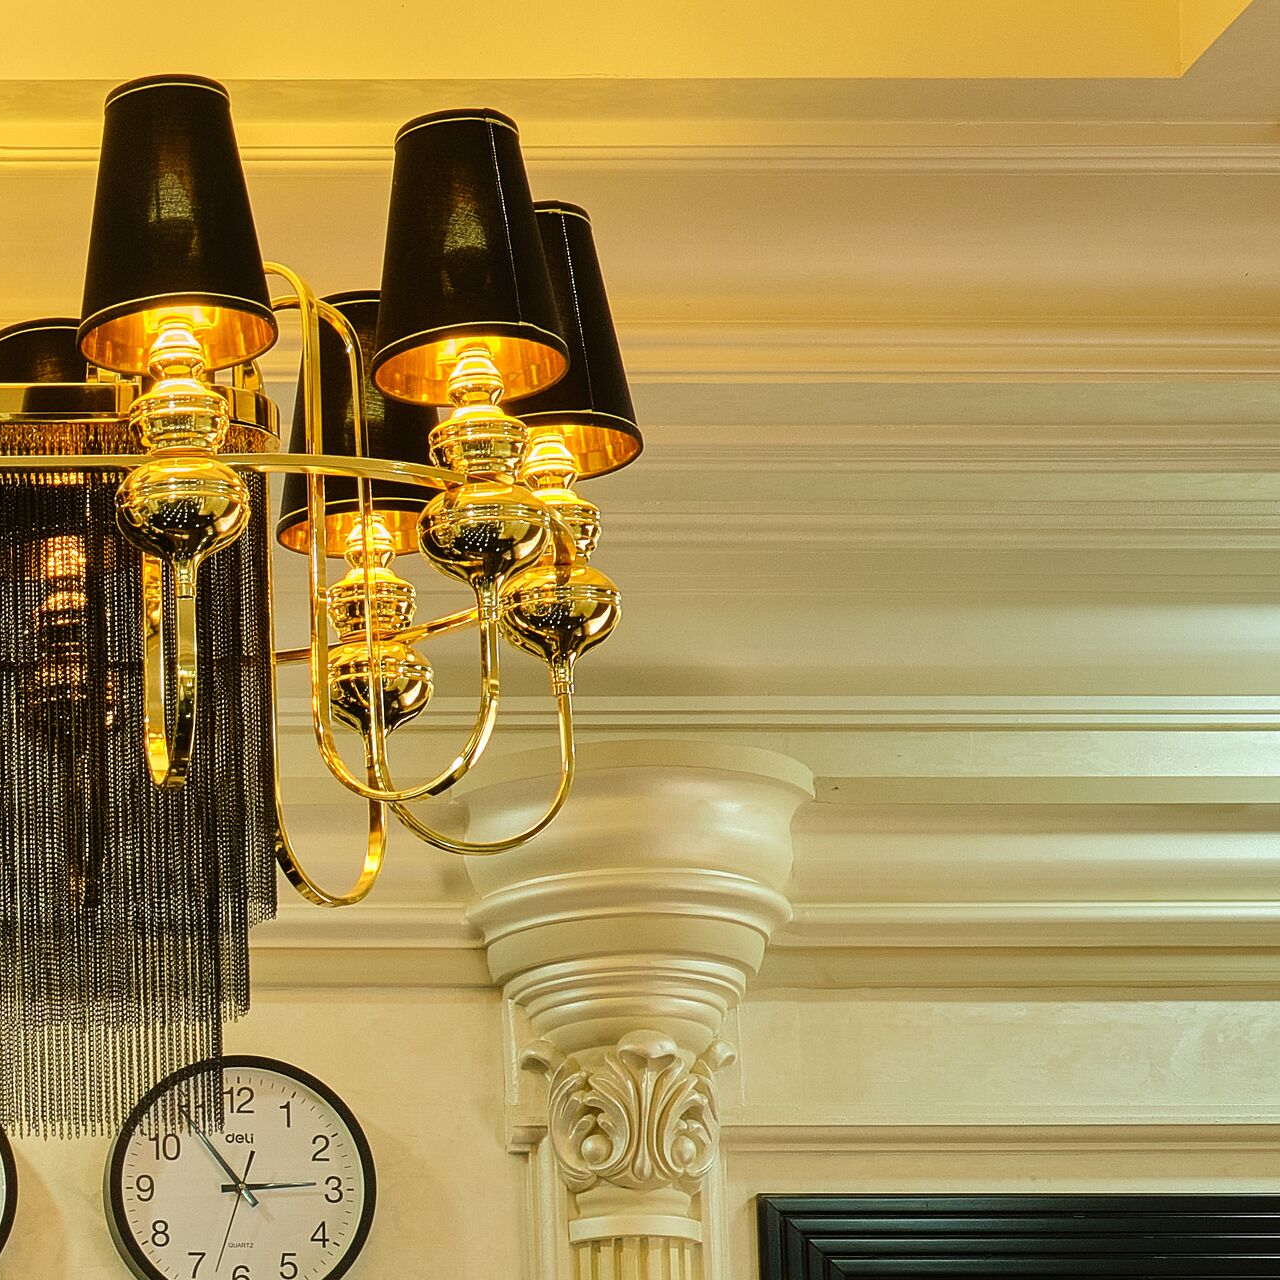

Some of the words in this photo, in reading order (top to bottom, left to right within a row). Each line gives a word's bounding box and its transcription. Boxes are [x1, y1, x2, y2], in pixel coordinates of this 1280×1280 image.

[224, 1087, 254, 1113] 12
[280, 1101, 290, 1127] 1
[149, 1134, 180, 1160] 10
[226, 1133, 254, 1144] deli
[312, 1135, 330, 1161] 2
[136, 1175, 154, 1201] 9
[325, 1176, 343, 1203] 3
[151, 1220, 169, 1247] 8
[311, 1221, 329, 1248] 4
[188, 1252, 206, 1278] 7
[280, 1253, 298, 1280] 5
